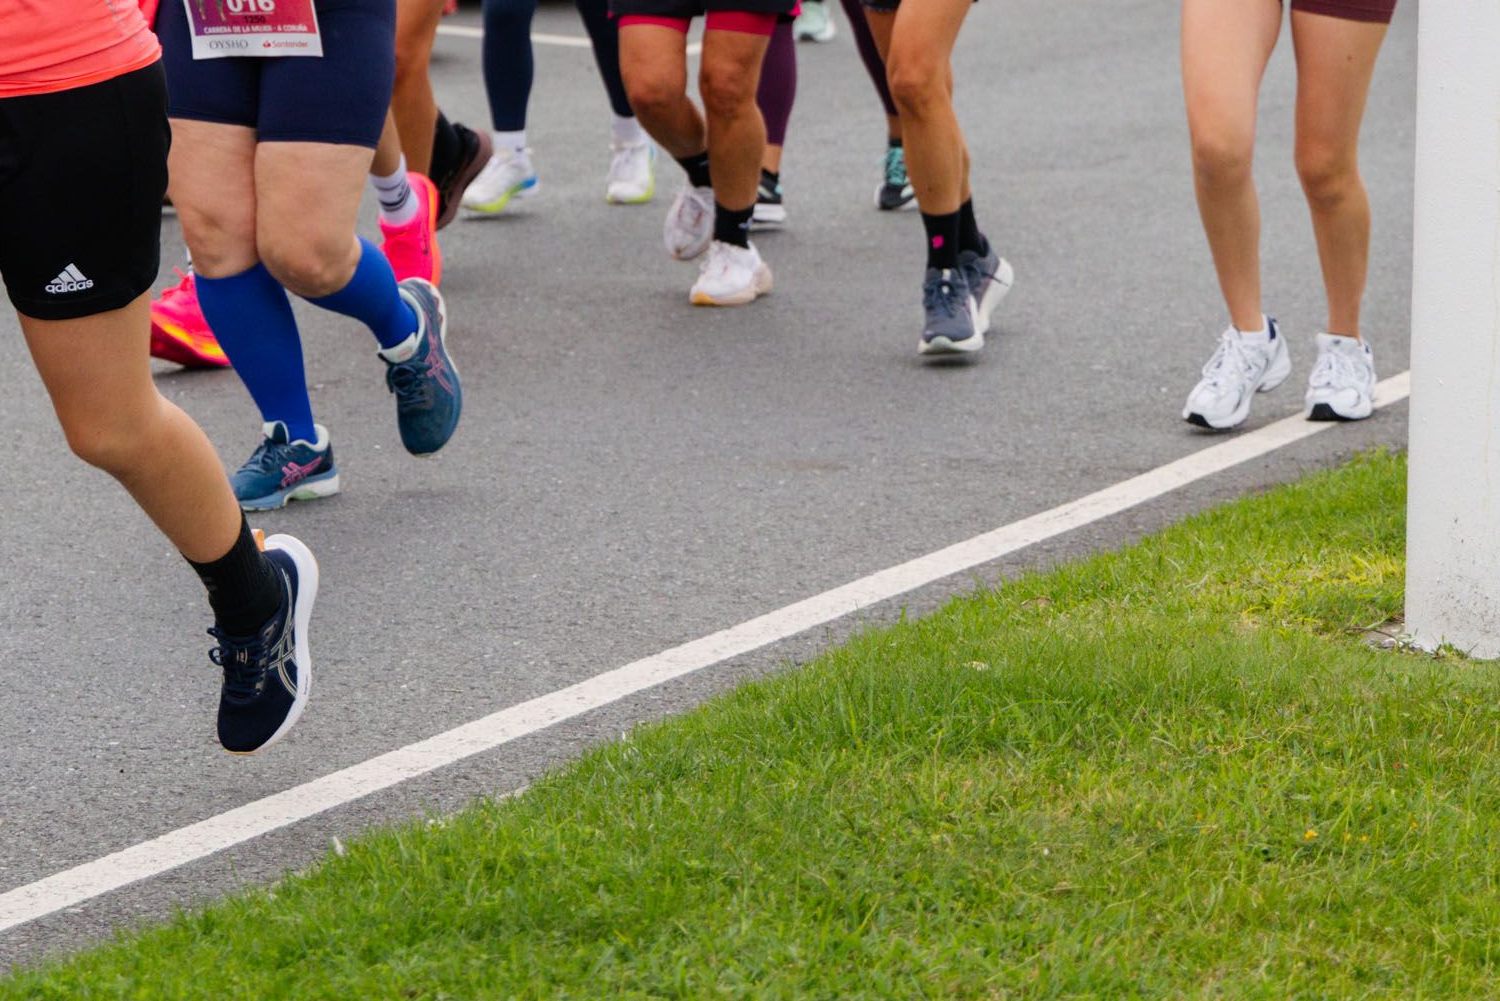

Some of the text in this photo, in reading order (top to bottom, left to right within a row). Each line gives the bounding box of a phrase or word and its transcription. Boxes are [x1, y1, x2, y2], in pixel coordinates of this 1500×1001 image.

[209, 40, 308, 49] OYSHO Santander
[45, 279, 94, 294] adidas
